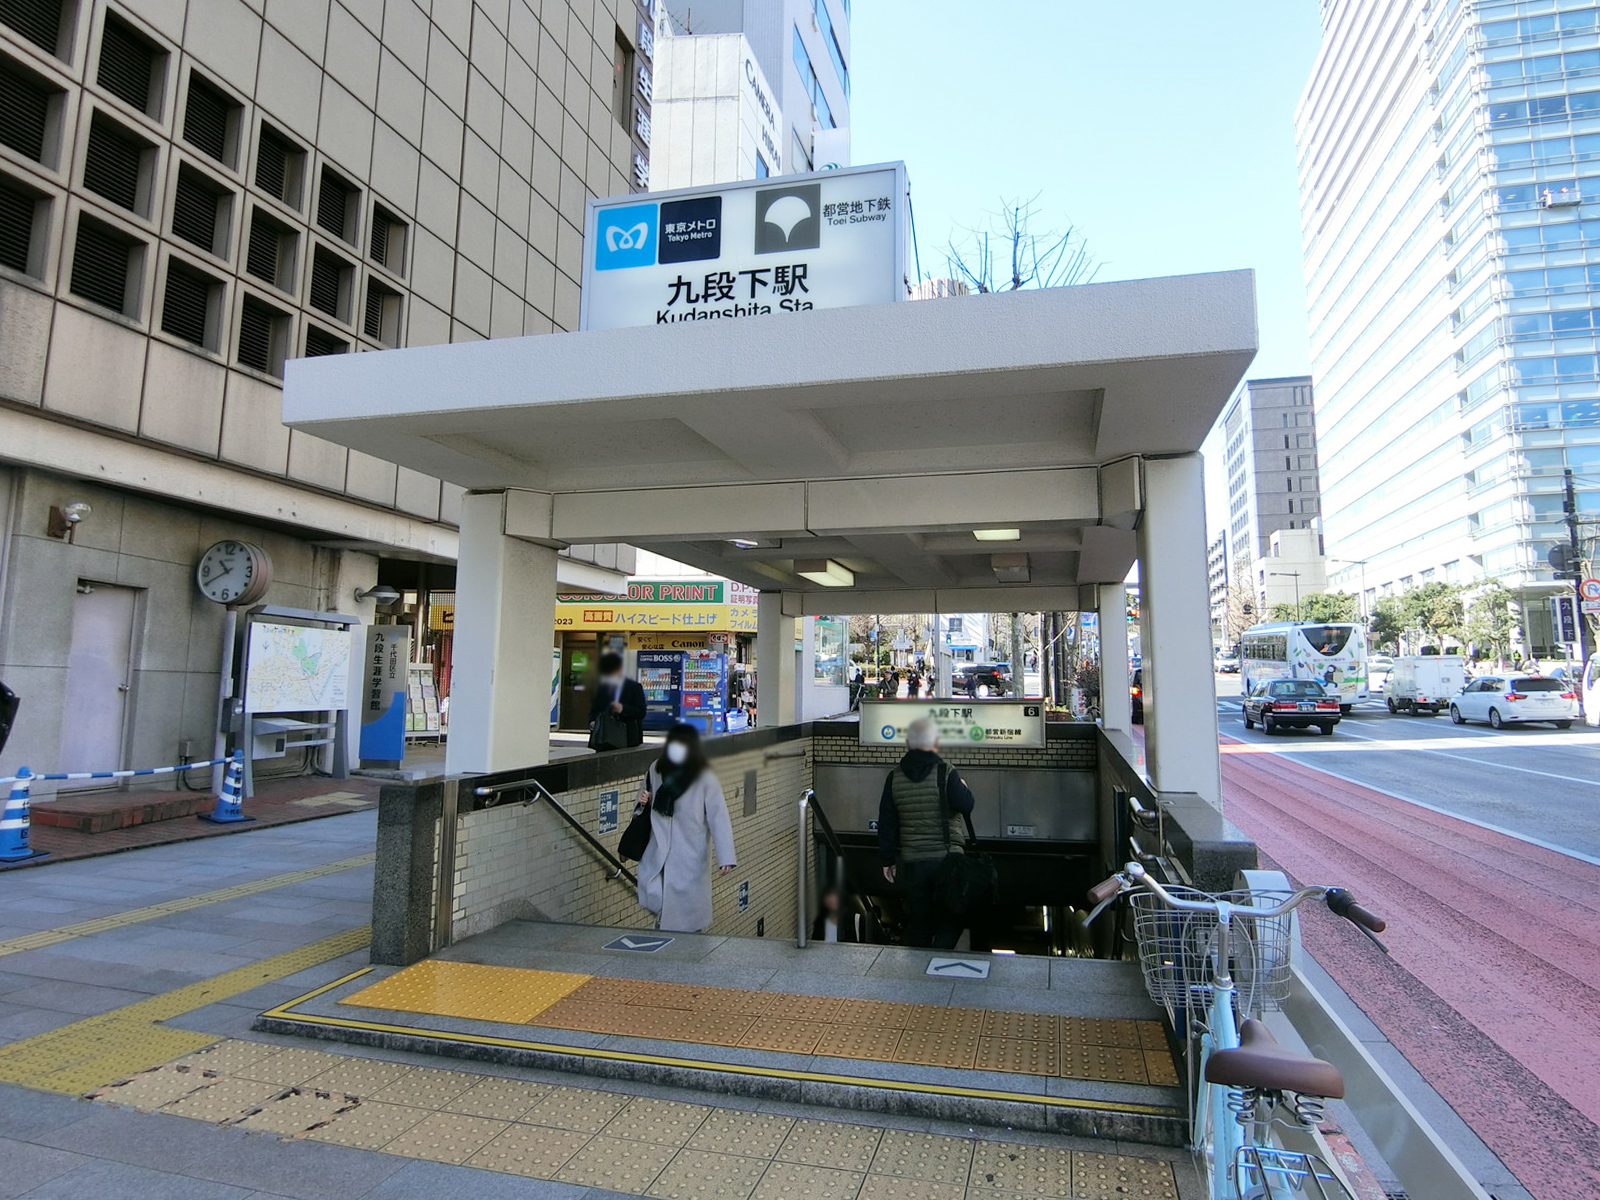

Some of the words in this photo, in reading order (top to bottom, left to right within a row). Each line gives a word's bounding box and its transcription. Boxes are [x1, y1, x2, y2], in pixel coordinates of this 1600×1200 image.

[746, 59, 775, 131] CAMERA
[762, 124, 780, 172] HIRAI
[823, 197, 891, 218] 都営地下鉄
[828, 216, 847, 226] Toei
[849, 213, 887, 224] Subway
[664, 219, 716, 235] 東京メトロ
[668, 234, 690, 242] Tokyo
[690, 231, 713, 240] Metro
[667, 263, 810, 307] 九段下駅
[656, 302, 772, 325] Kudanshita
[225, 543, 236, 556] 12
[202, 565, 210, 578] 9
[245, 565, 252, 578] 3
[221, 588, 229, 601] 6
[659, 584, 718, 601] PRINT
[615, 613, 717, 625] ハイスピード仕上げ
[1562, 602, 1574, 640] 九段下
[671, 639, 705, 648] Canon
[388, 643, 398, 679] 千代田区立
[653, 654, 673, 662] BOSS
[370, 632, 384, 711] 九段生涯学習館
[927, 708, 972, 719] 九段下駅
[1028, 707, 1036, 716] 6
[985, 728, 1022, 736] 都営新宿線
